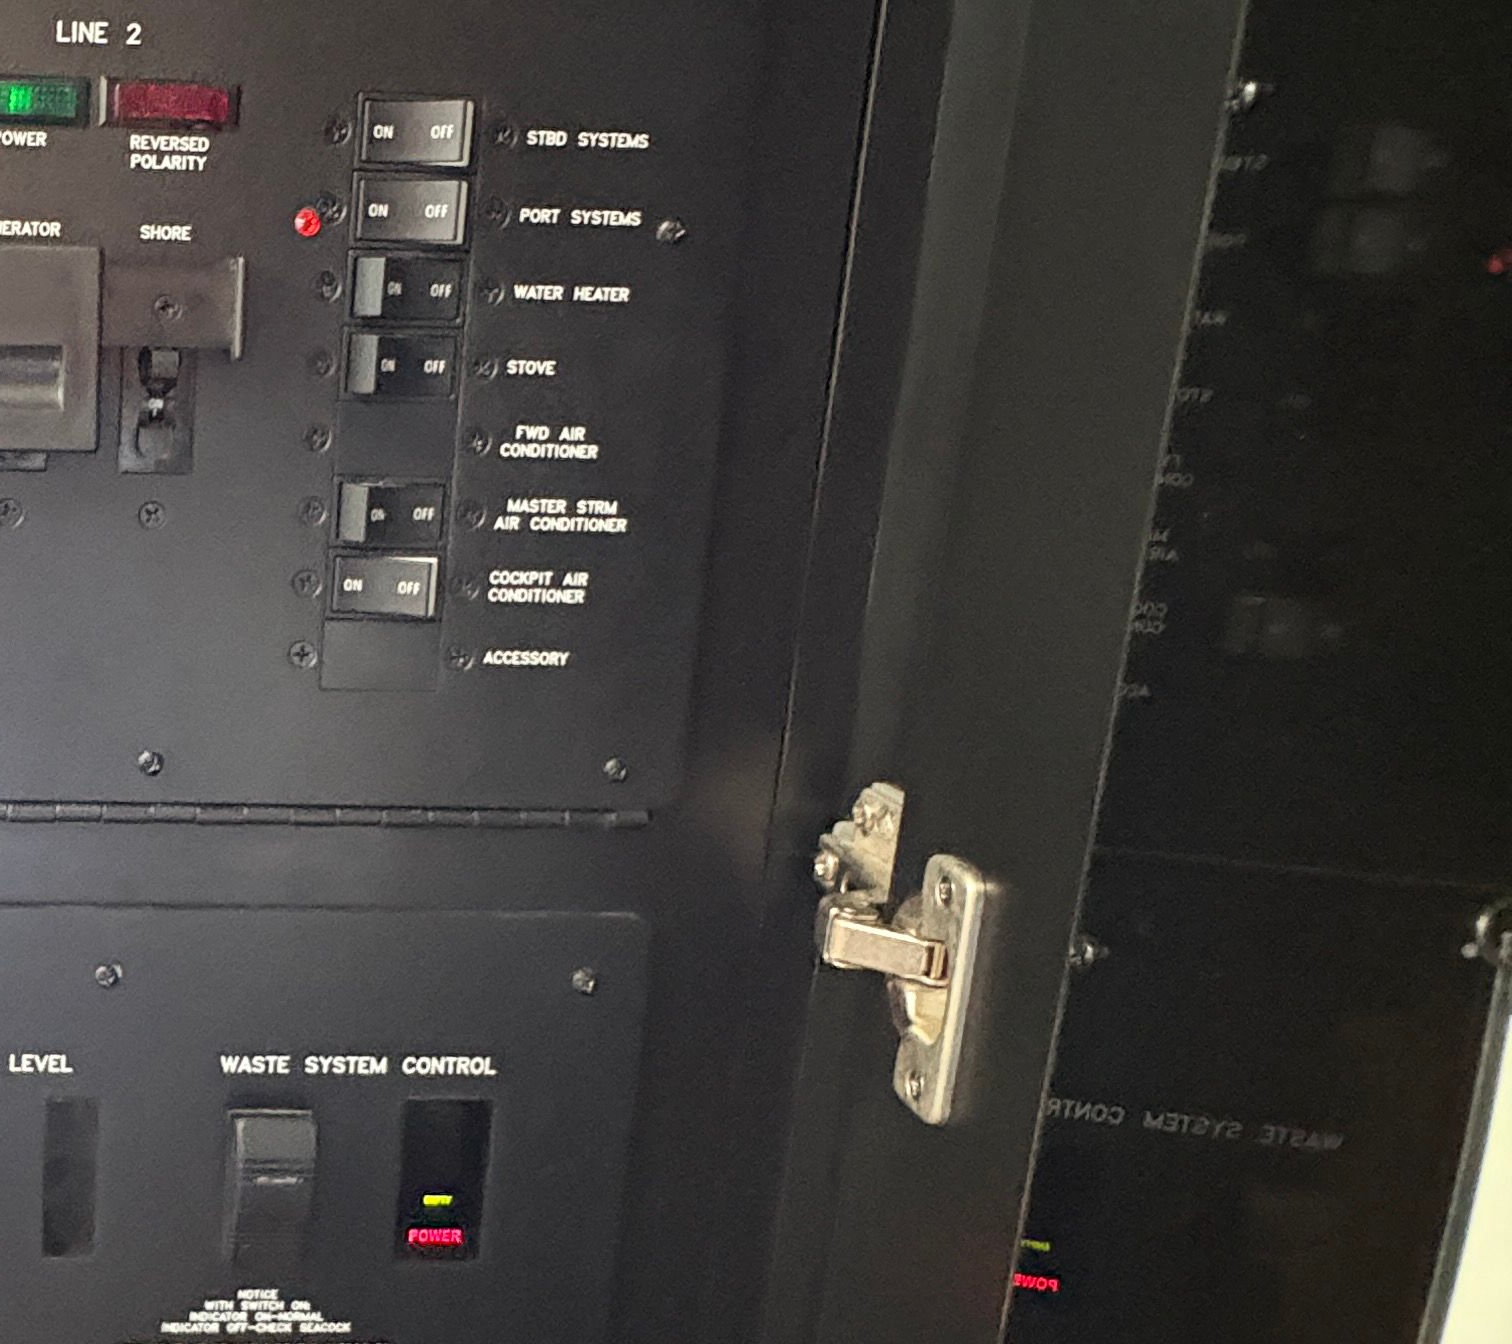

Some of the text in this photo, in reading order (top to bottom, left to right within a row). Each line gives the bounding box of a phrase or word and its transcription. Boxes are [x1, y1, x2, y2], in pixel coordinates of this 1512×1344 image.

[56, 20, 142, 45] LINE 2
[374, 125, 454, 139] ON OFF
[526, 131, 649, 148] STBD SYSTEMS
[130, 135, 209, 153] REVERSED
[130, 154, 207, 171] POLARITY
[368, 204, 448, 218] ON OFF
[520, 208, 641, 226] PORT SYSTEMS
[140, 225, 191, 241] SHORE
[514, 285, 630, 302] WATER HEATER
[507, 360, 556, 375] STOVE
[516, 425, 585, 441] FWD AIR
[500, 443, 598, 459] CONDITIONER
[507, 499, 617, 515] MASTER STRM
[494, 516, 627, 532] AIR CONDITIONER
[489, 571, 588, 586] COCKPIT AIR
[488, 588, 584, 604] CONDITIONER
[482, 651, 570, 665] ACCESSORY
[9, 1054, 73, 1073] LEVEL
[221, 1055, 496, 1076] WASTE SYSTEM CONTROL
[408, 1228, 463, 1244] POWER
[238, 1289, 279, 1299] NOTICE
